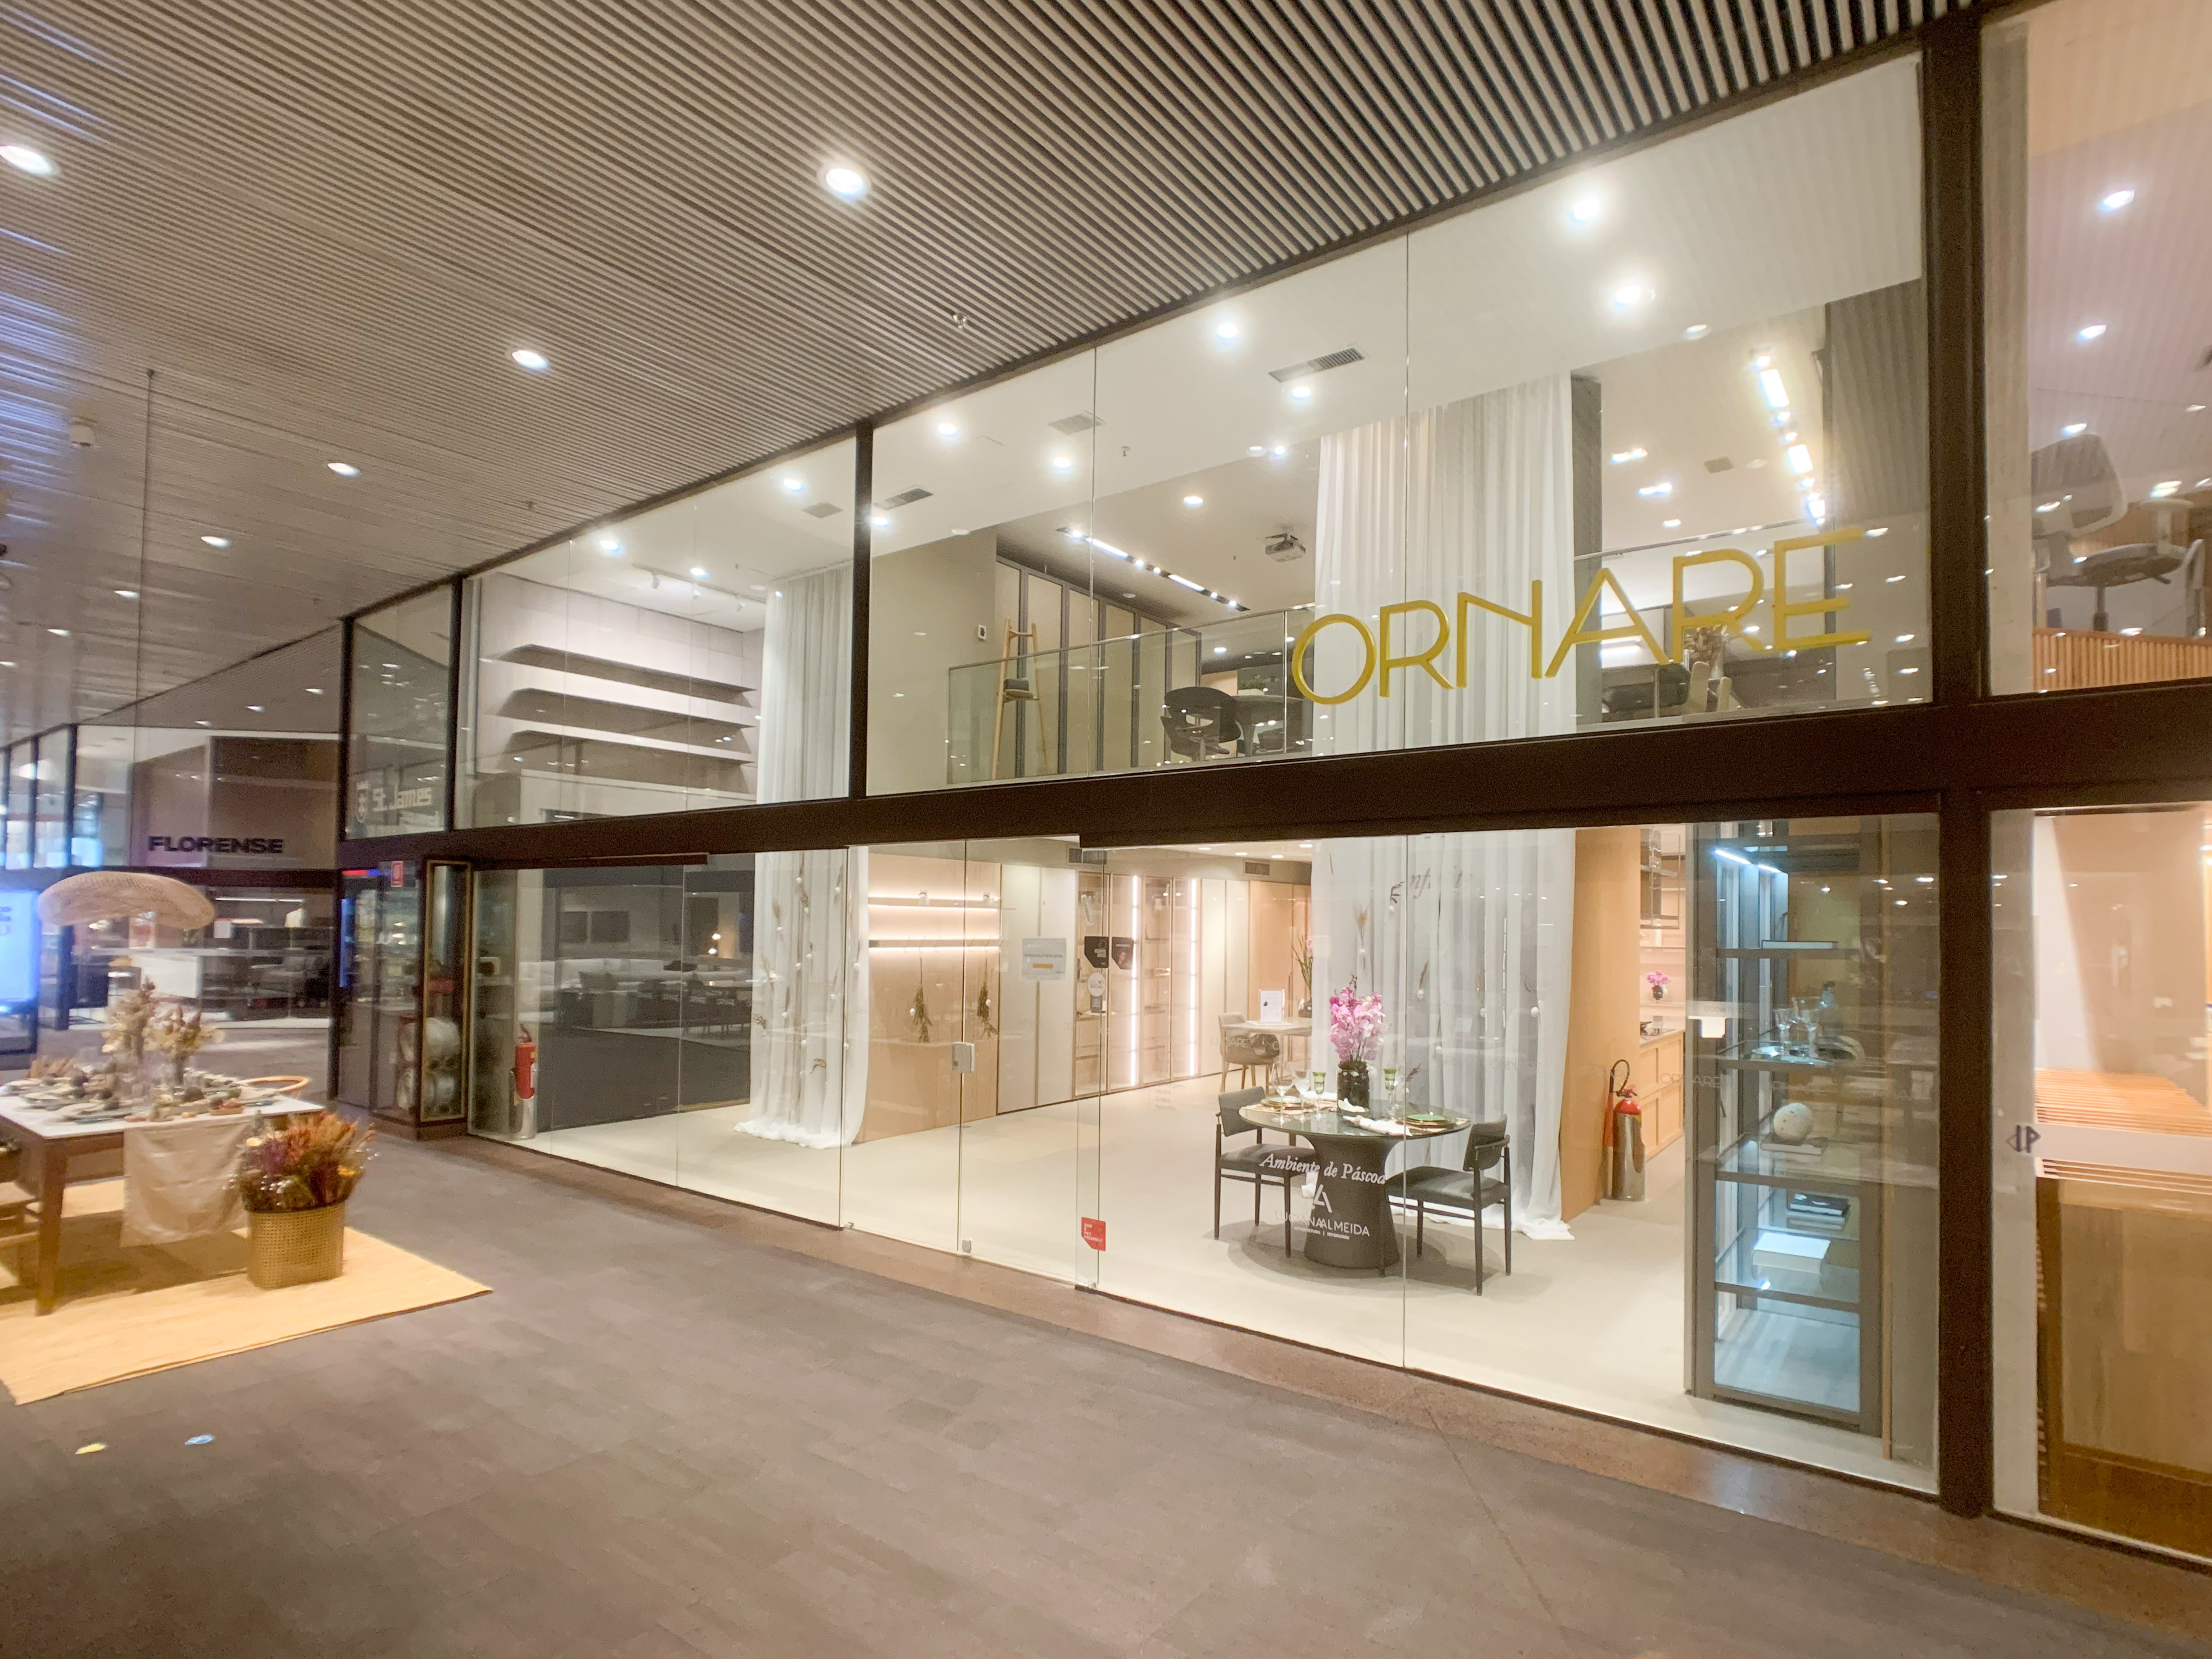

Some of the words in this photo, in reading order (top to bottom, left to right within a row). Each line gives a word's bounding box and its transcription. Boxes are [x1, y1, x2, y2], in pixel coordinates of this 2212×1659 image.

[1291, 527, 1873, 705] ORNARE
[148, 836, 283, 853] FLORENSE
[1259, 1153, 1321, 1173] Ambiente
[1323, 1161, 1338, 1177] de
[1341, 1163, 1386, 1185] Páscoa
